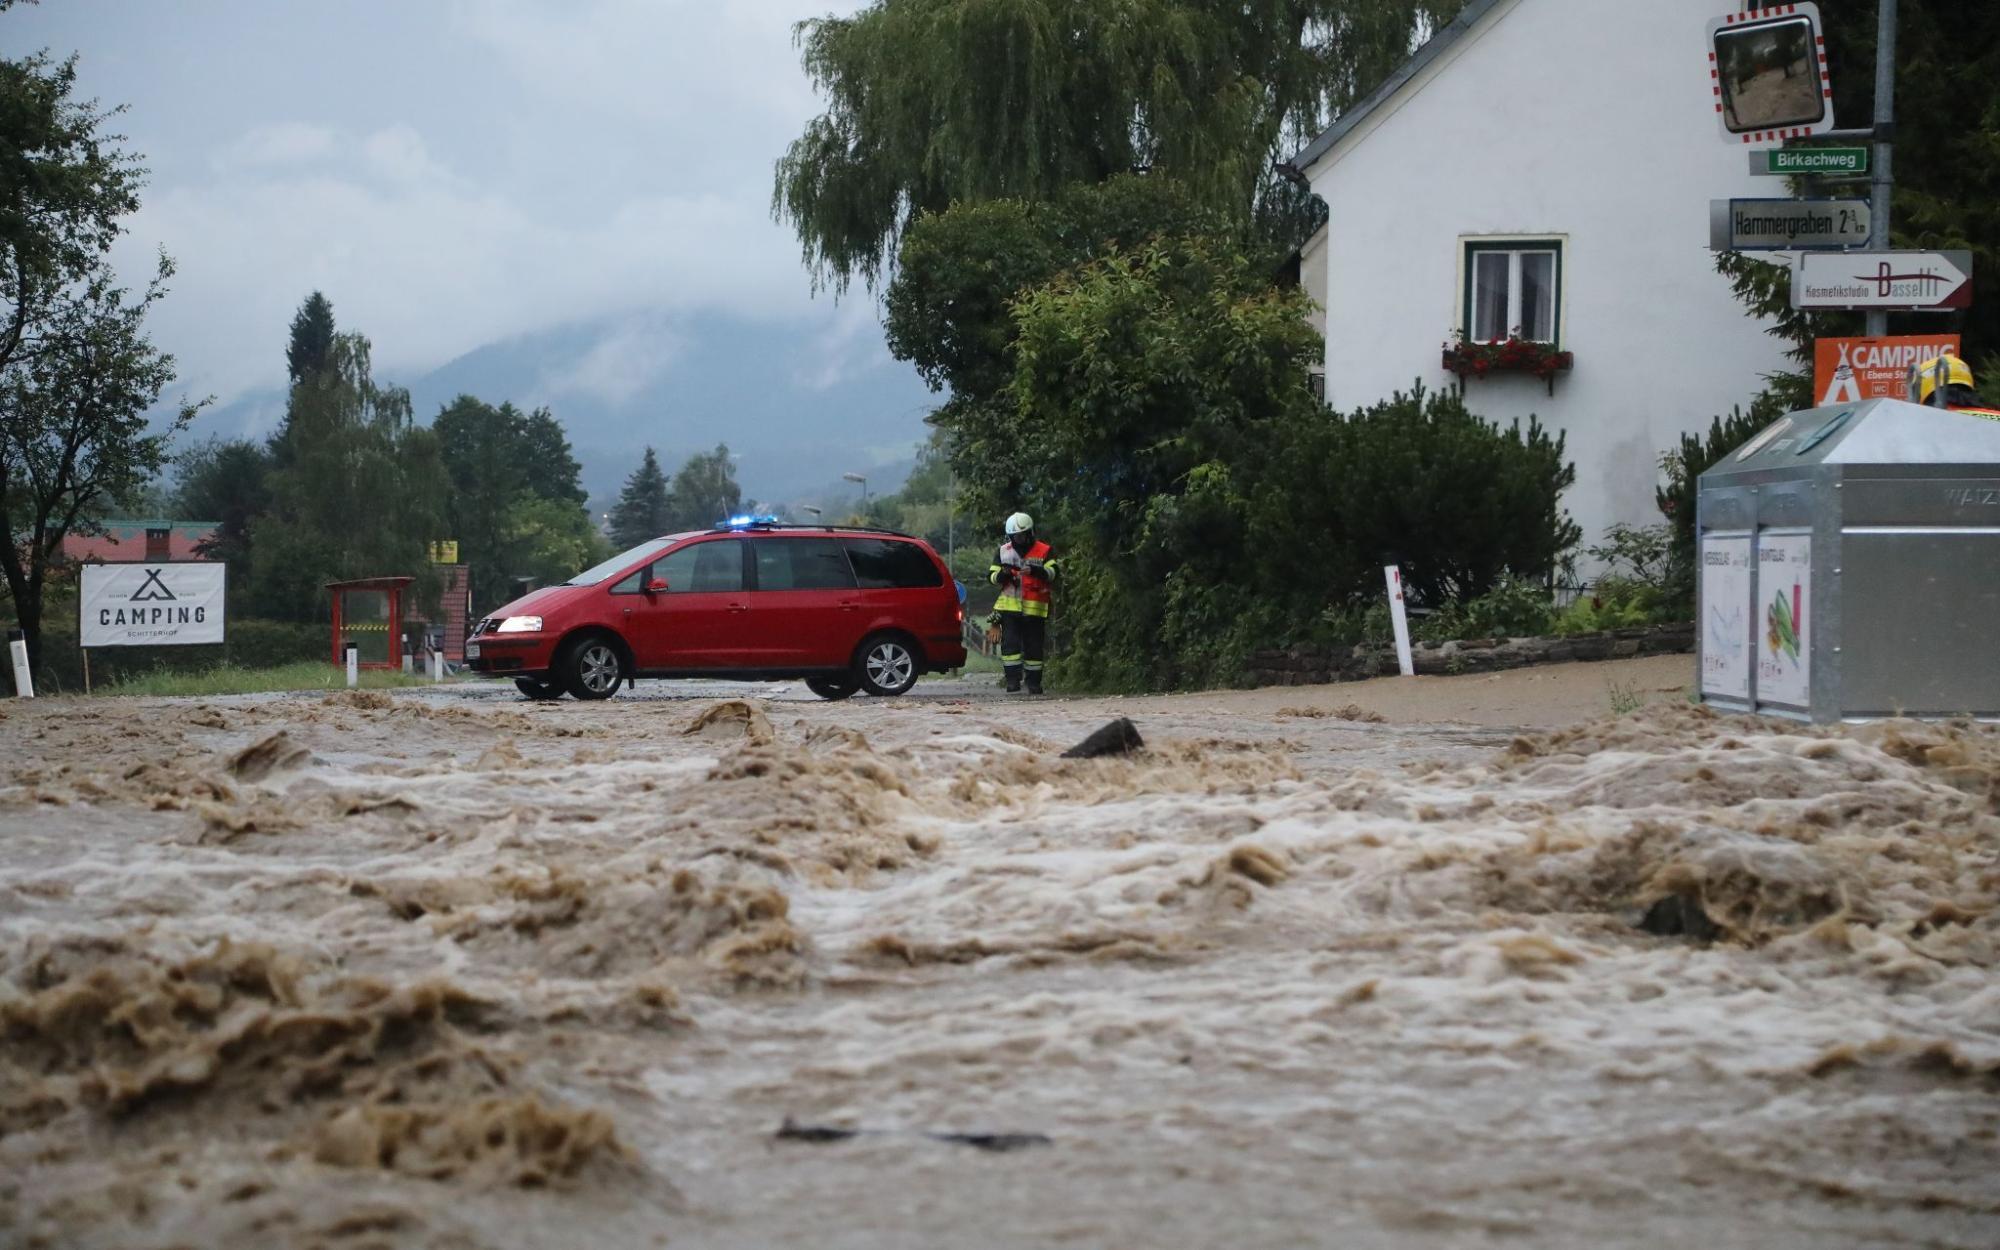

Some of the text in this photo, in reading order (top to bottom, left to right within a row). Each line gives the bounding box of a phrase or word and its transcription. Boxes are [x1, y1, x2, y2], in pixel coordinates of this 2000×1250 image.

[1777, 153, 1856, 168] Birkachweg
[1735, 210, 1833, 239] Hammergraben
[1805, 285, 1869, 298] Kosmetikstudio
[100, 606, 205, 625] CAMPING
